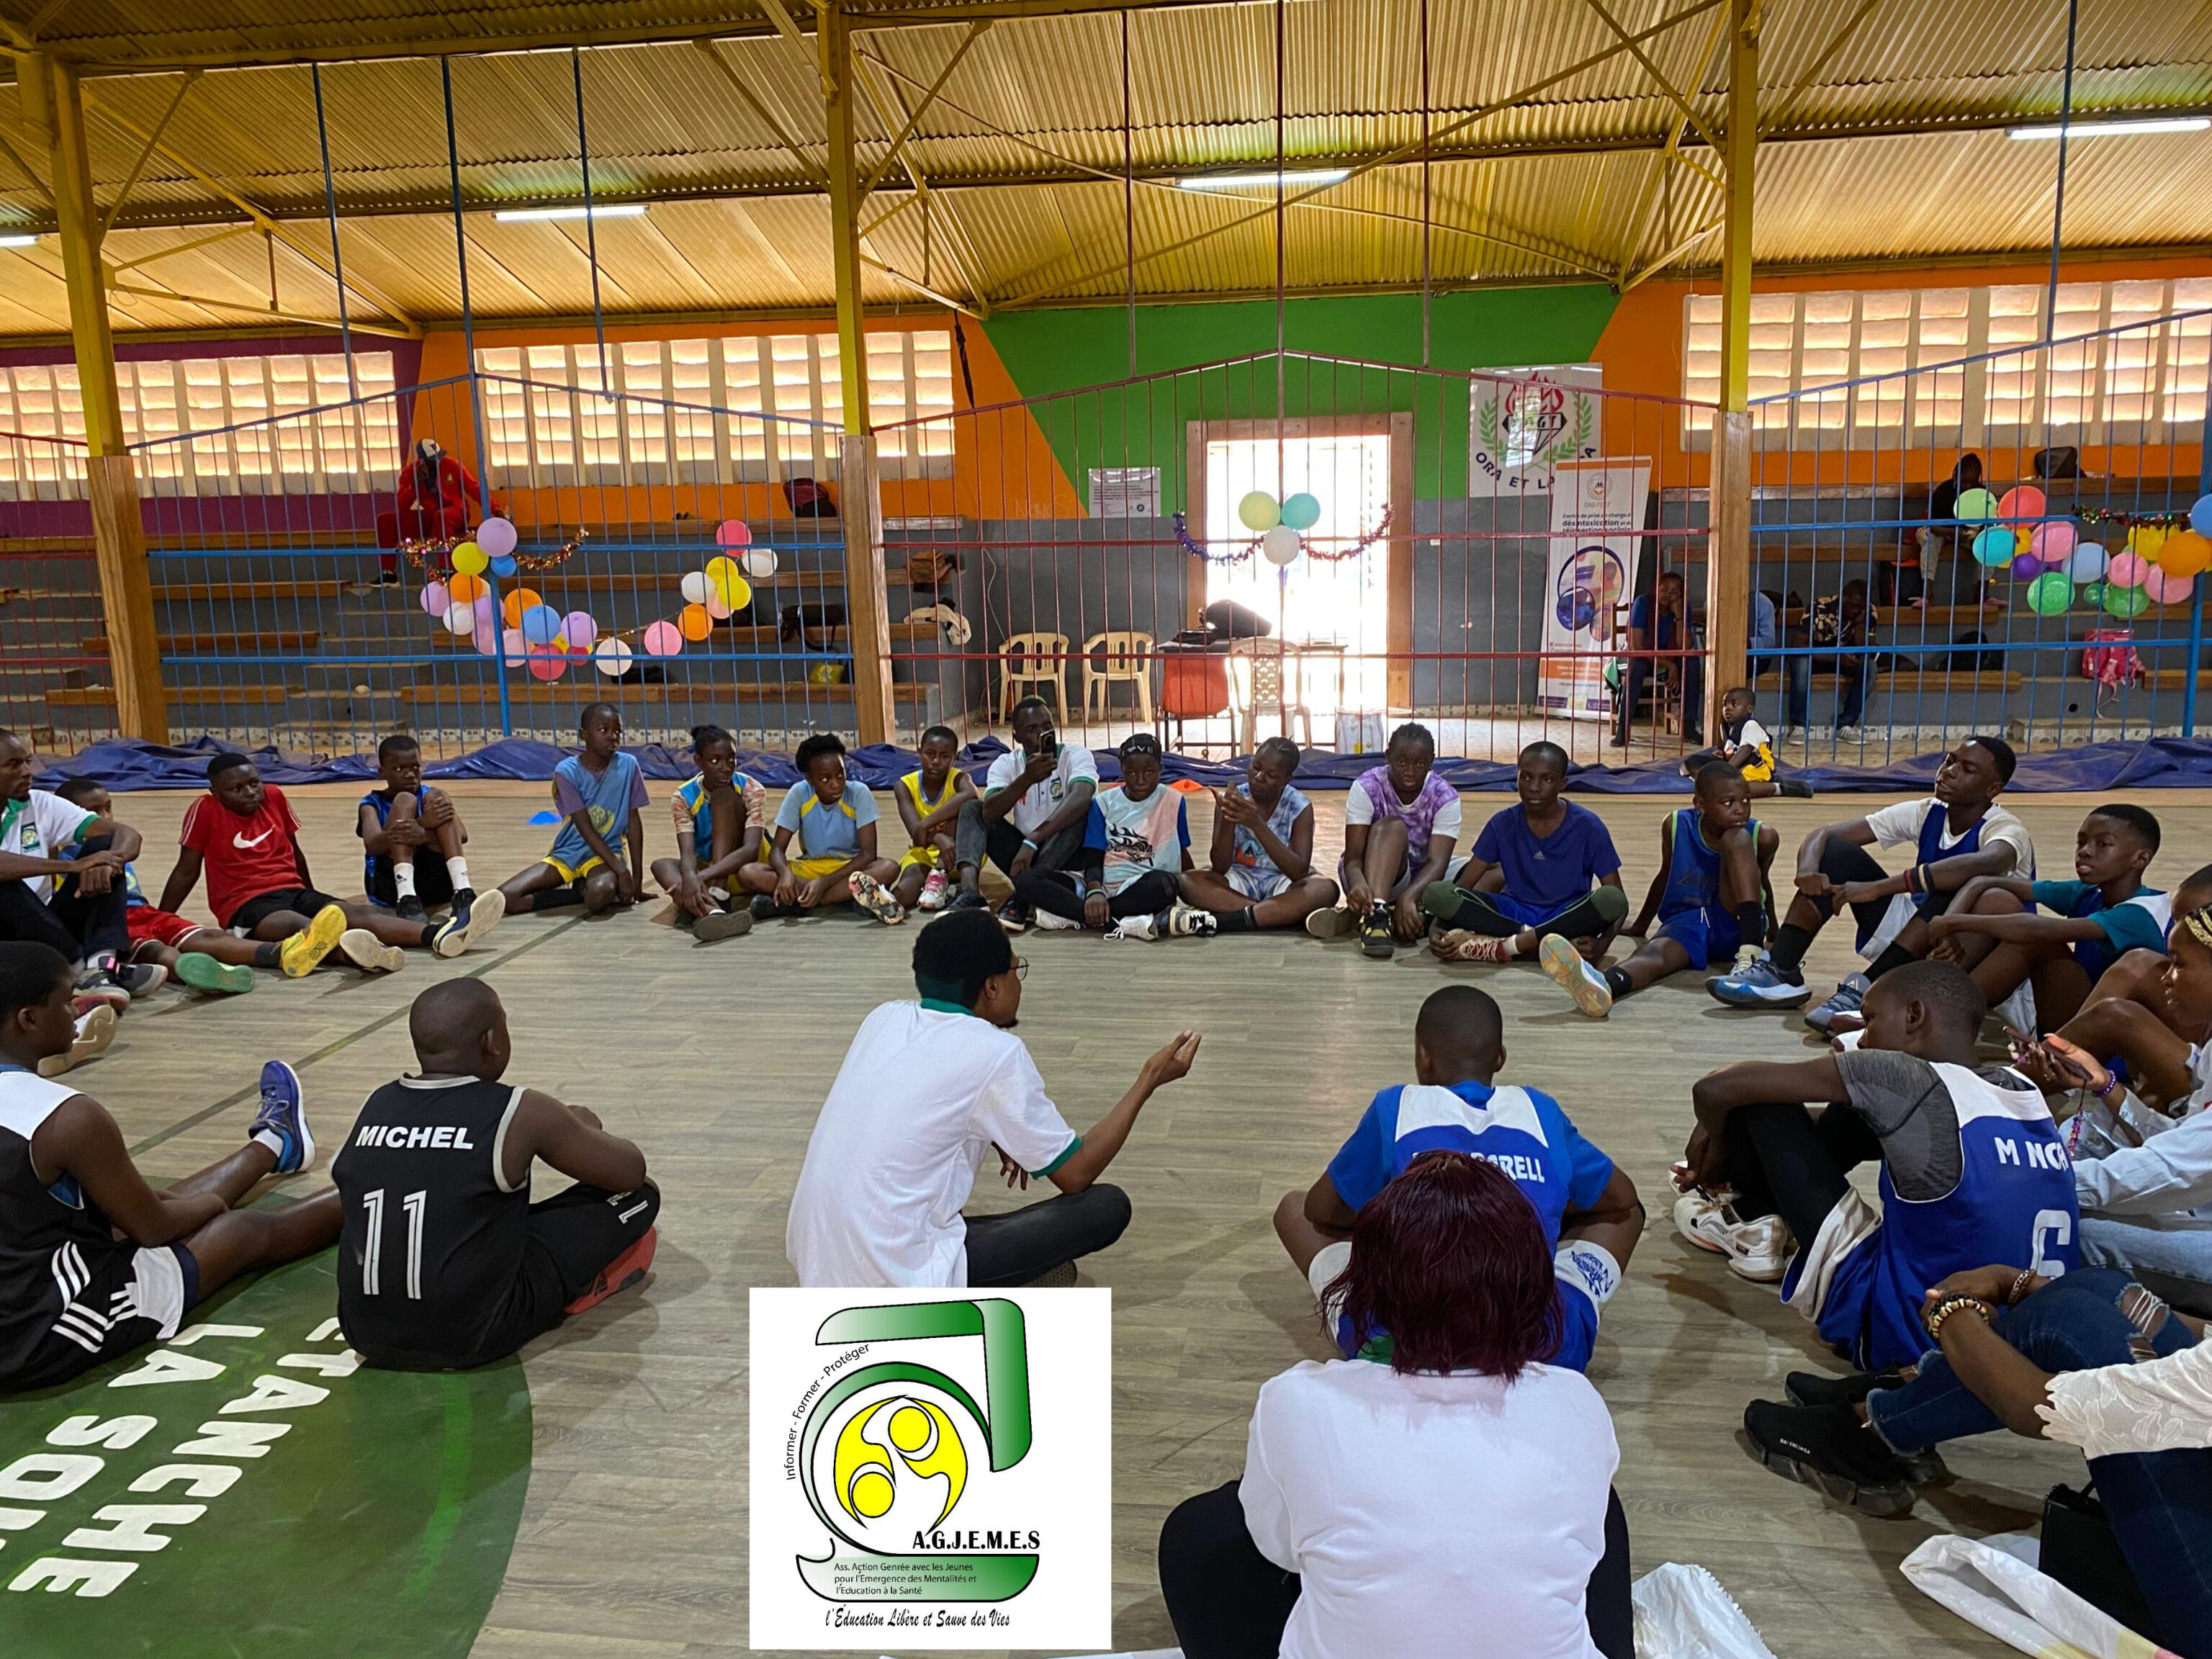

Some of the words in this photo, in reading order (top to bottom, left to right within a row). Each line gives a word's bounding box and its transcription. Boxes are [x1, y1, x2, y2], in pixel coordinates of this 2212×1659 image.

[1475, 452, 1502, 481] ORA
[1509, 476, 1529, 490] ET
[356, 1125, 474, 1150] MICHEL
[1994, 1136, 2020, 1166] M
[363, 1188, 427, 1300] 11
[107, 1323, 265, 1388] LA
